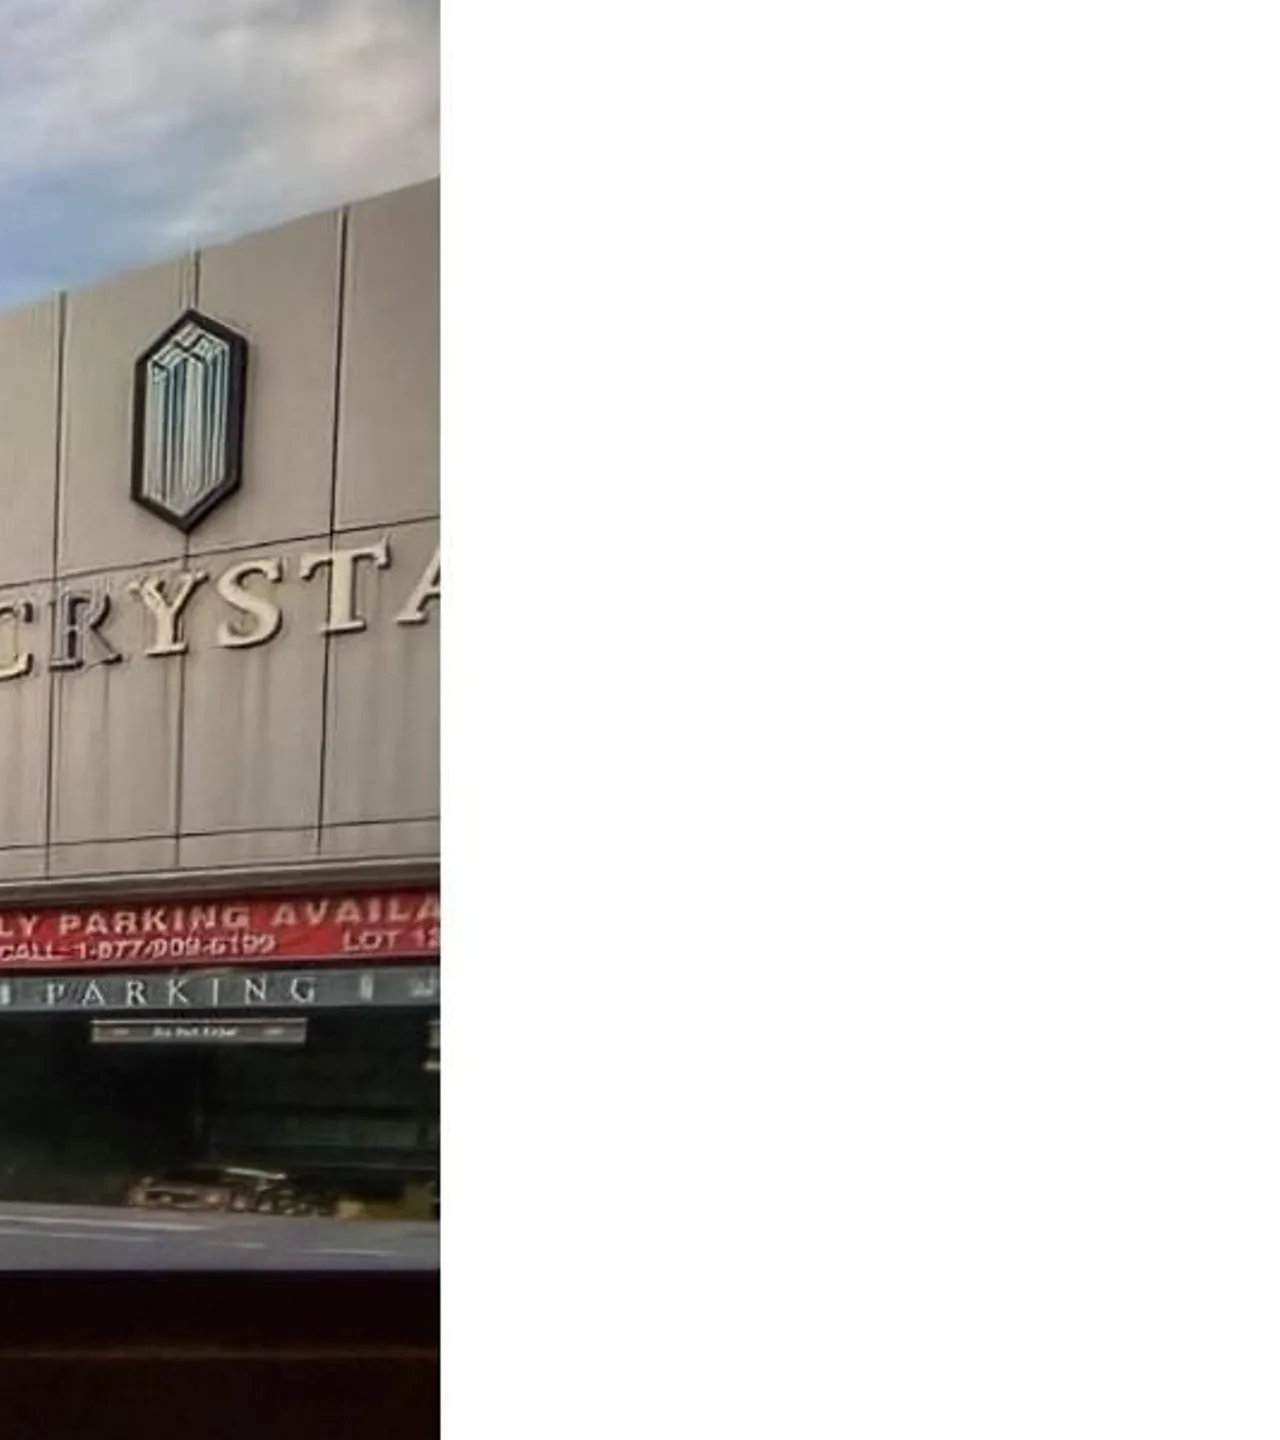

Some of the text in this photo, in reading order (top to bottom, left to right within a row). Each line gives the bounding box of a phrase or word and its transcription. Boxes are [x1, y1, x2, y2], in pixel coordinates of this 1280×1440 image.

[59, 905, 251, 937] PARKING
[341, 927, 404, 952] LOT
[46, 976, 315, 1007] PARKING
